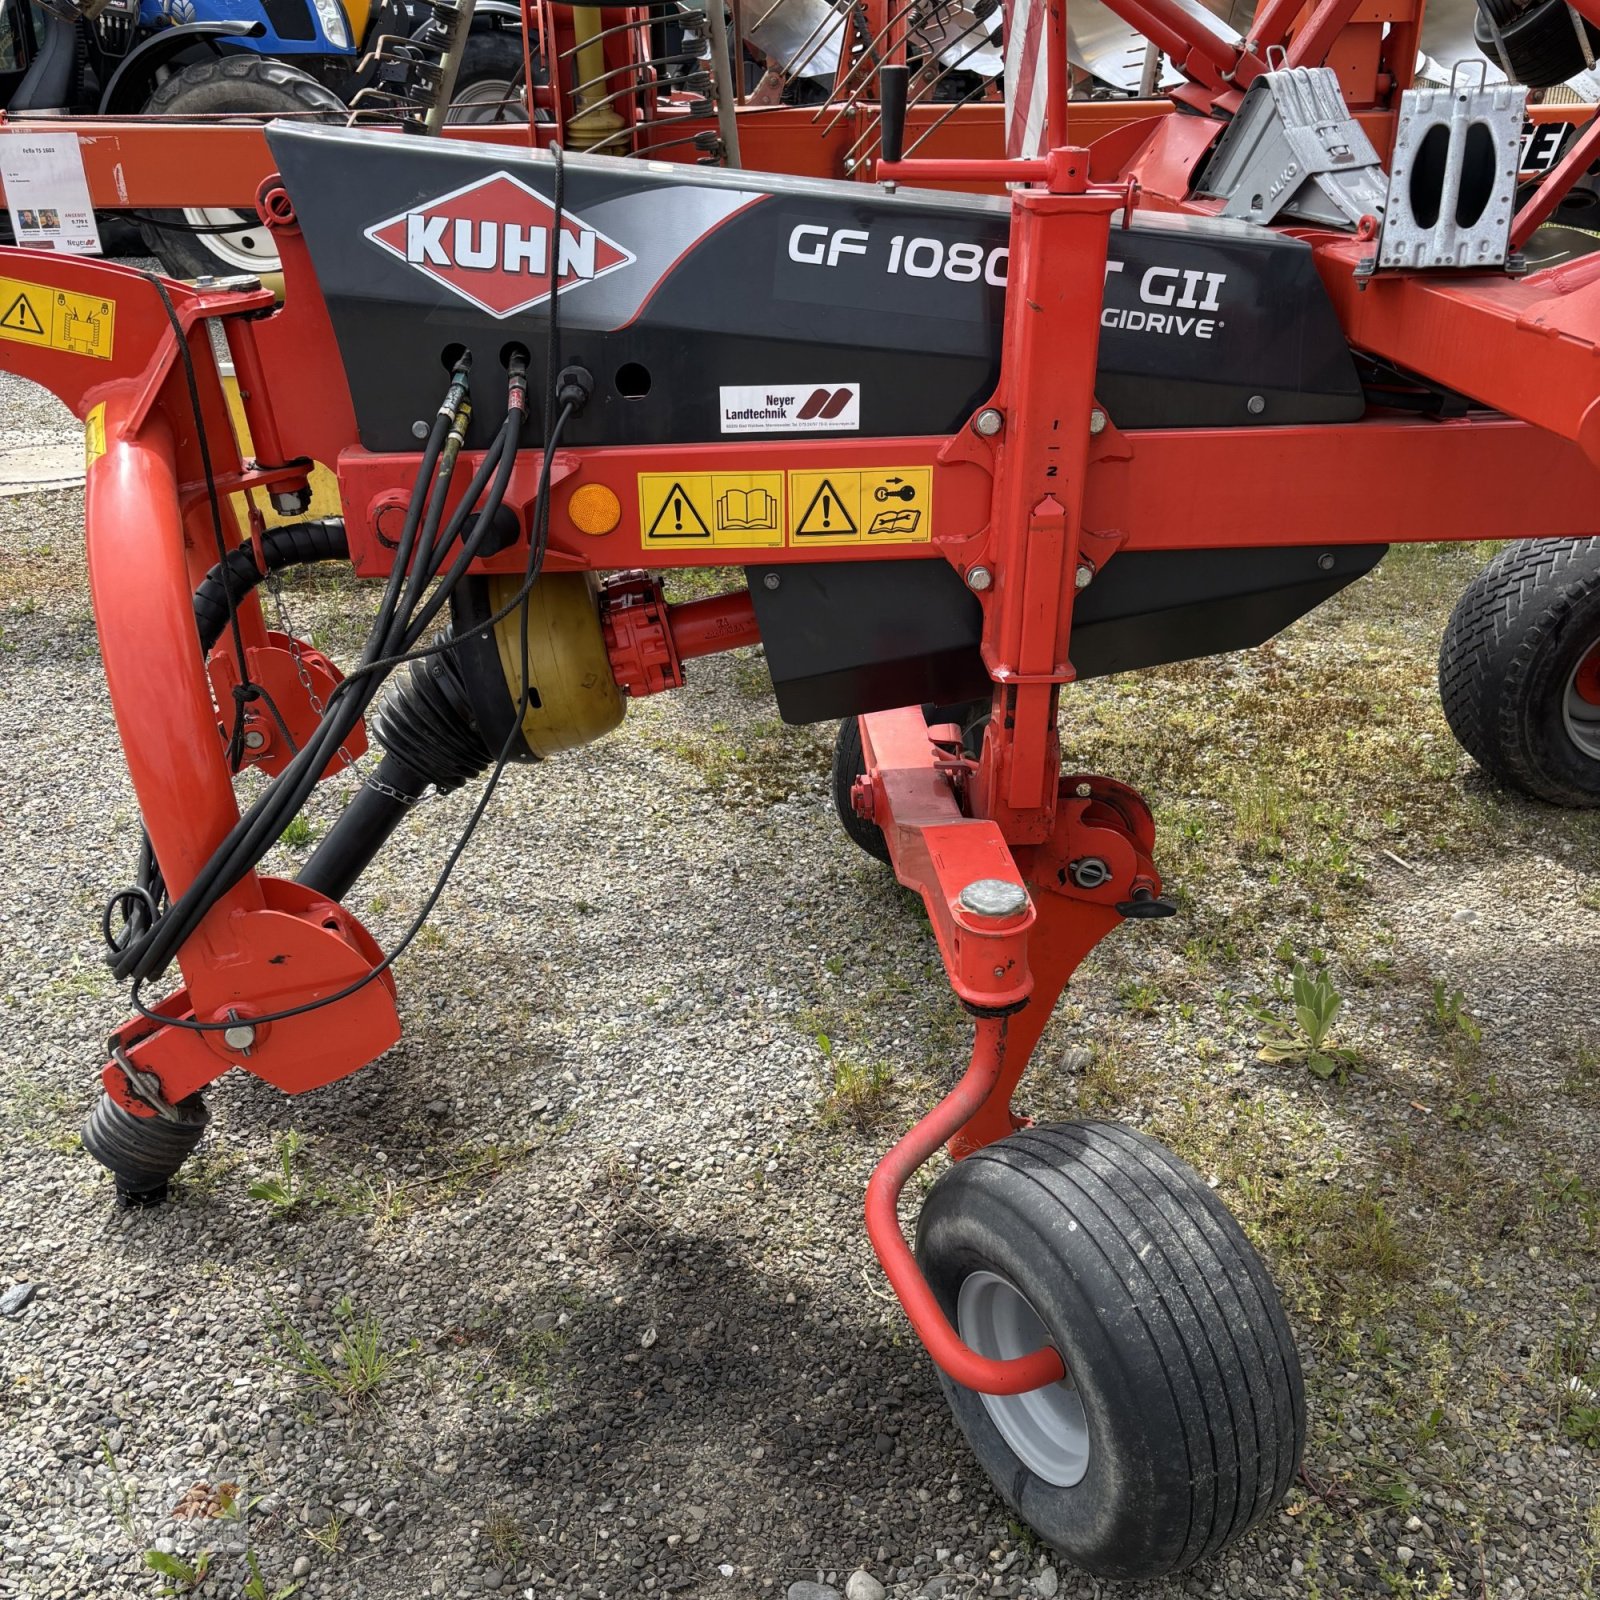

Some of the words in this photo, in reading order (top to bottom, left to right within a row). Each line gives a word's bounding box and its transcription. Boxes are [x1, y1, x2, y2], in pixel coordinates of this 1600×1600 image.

[407, 213, 596, 279] KUHN
[788, 224, 869, 267] GF
[766, 395, 796, 408] Neyer
[725, 408, 787, 420] Landtechnik
[1046, 466, 1058, 477] 2
